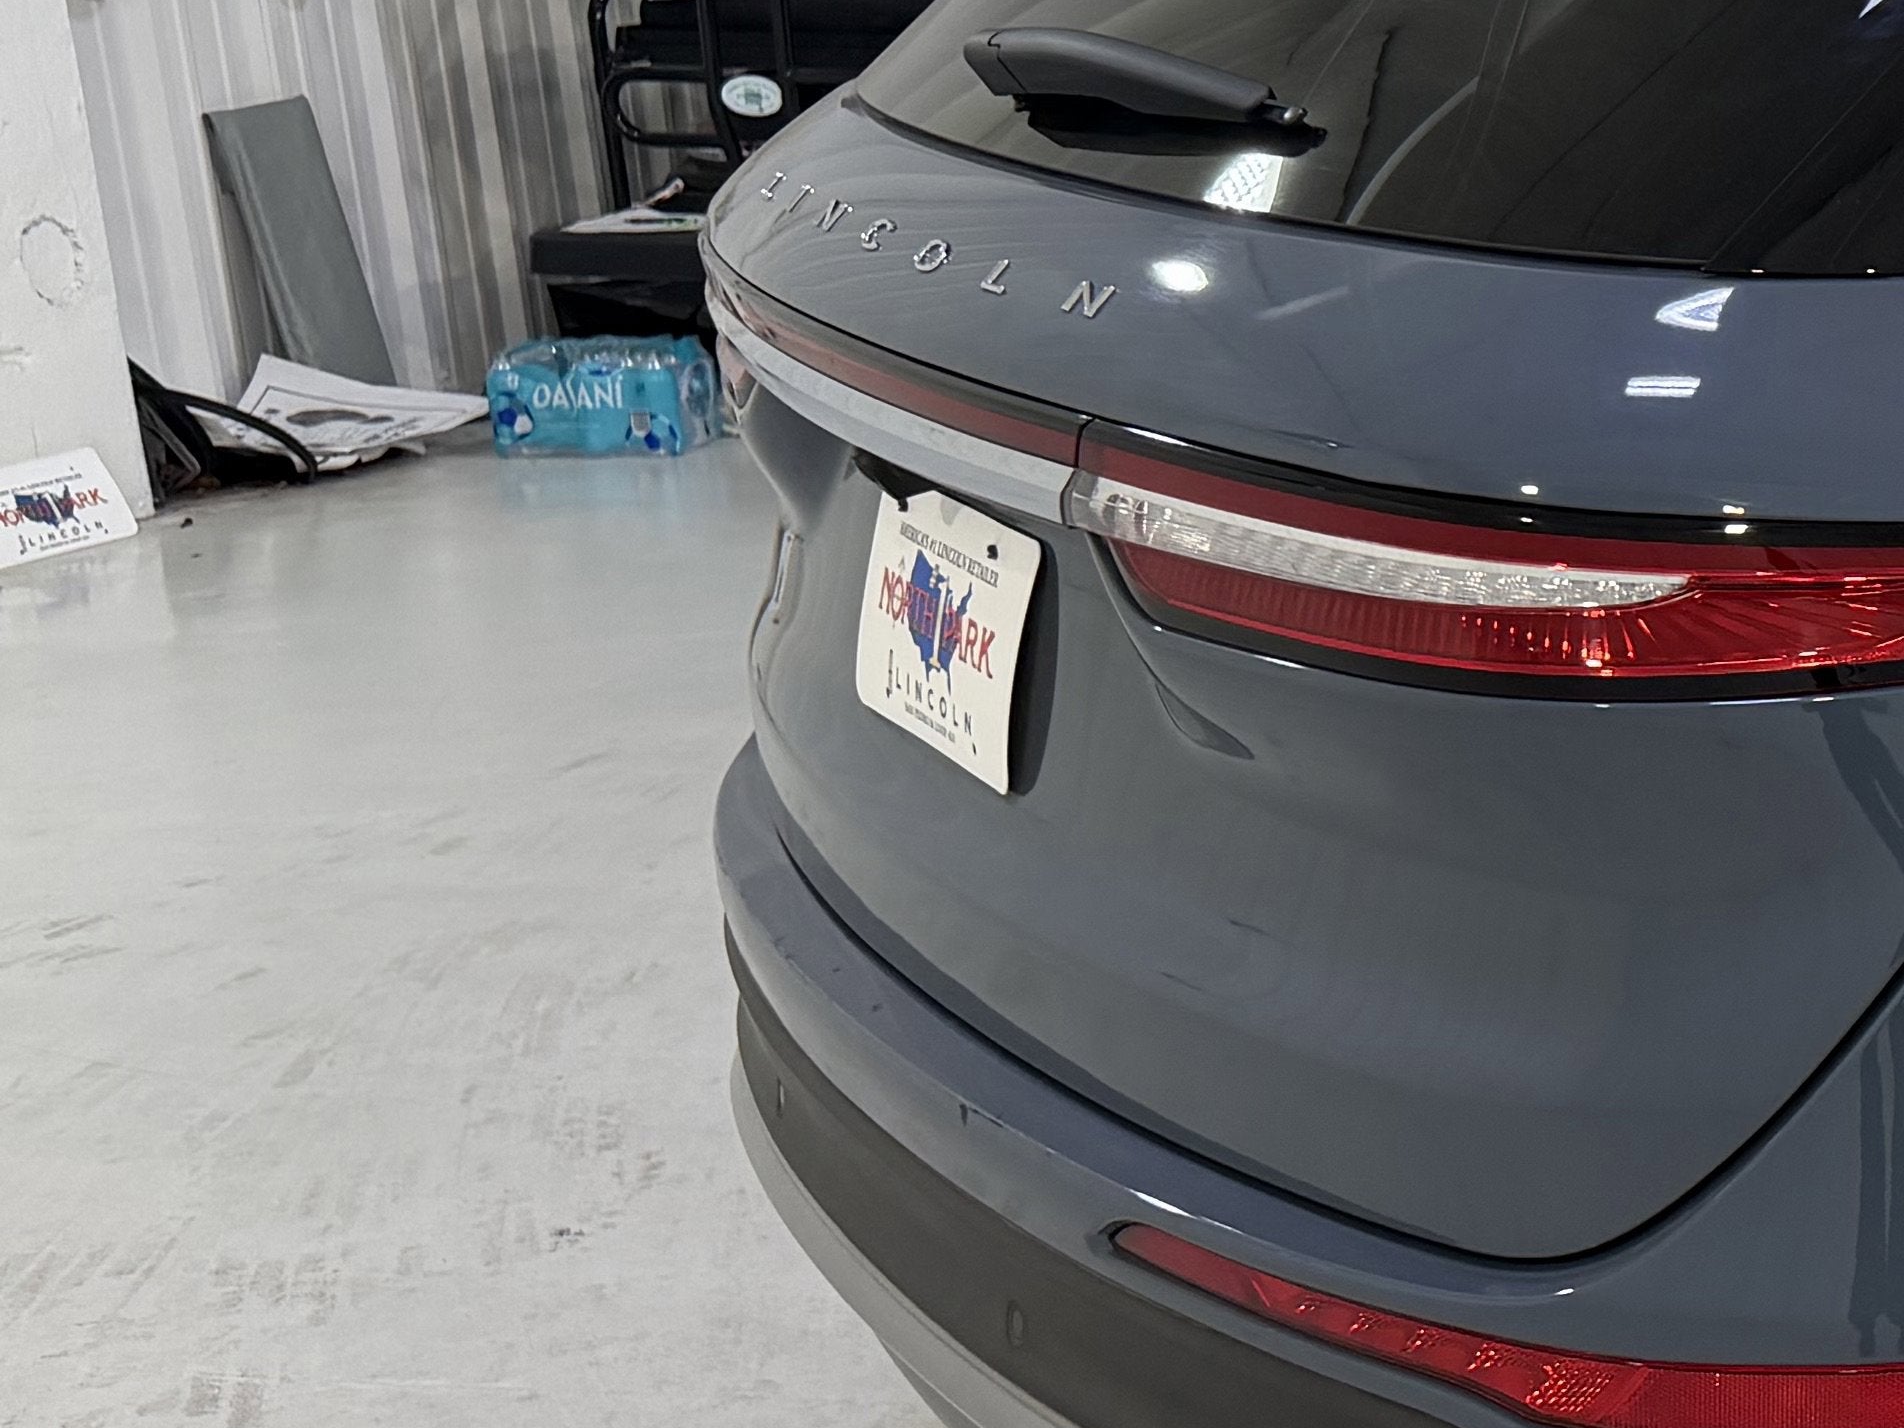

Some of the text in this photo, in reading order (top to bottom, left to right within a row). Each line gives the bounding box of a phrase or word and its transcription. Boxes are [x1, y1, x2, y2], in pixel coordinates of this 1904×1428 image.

[760, 172, 1119, 319] LINCOLN
[28, 520, 104, 548] LINCOLN
[879, 567, 996, 680] NORTH PARK
[896, 667, 972, 737] LINCOLN
